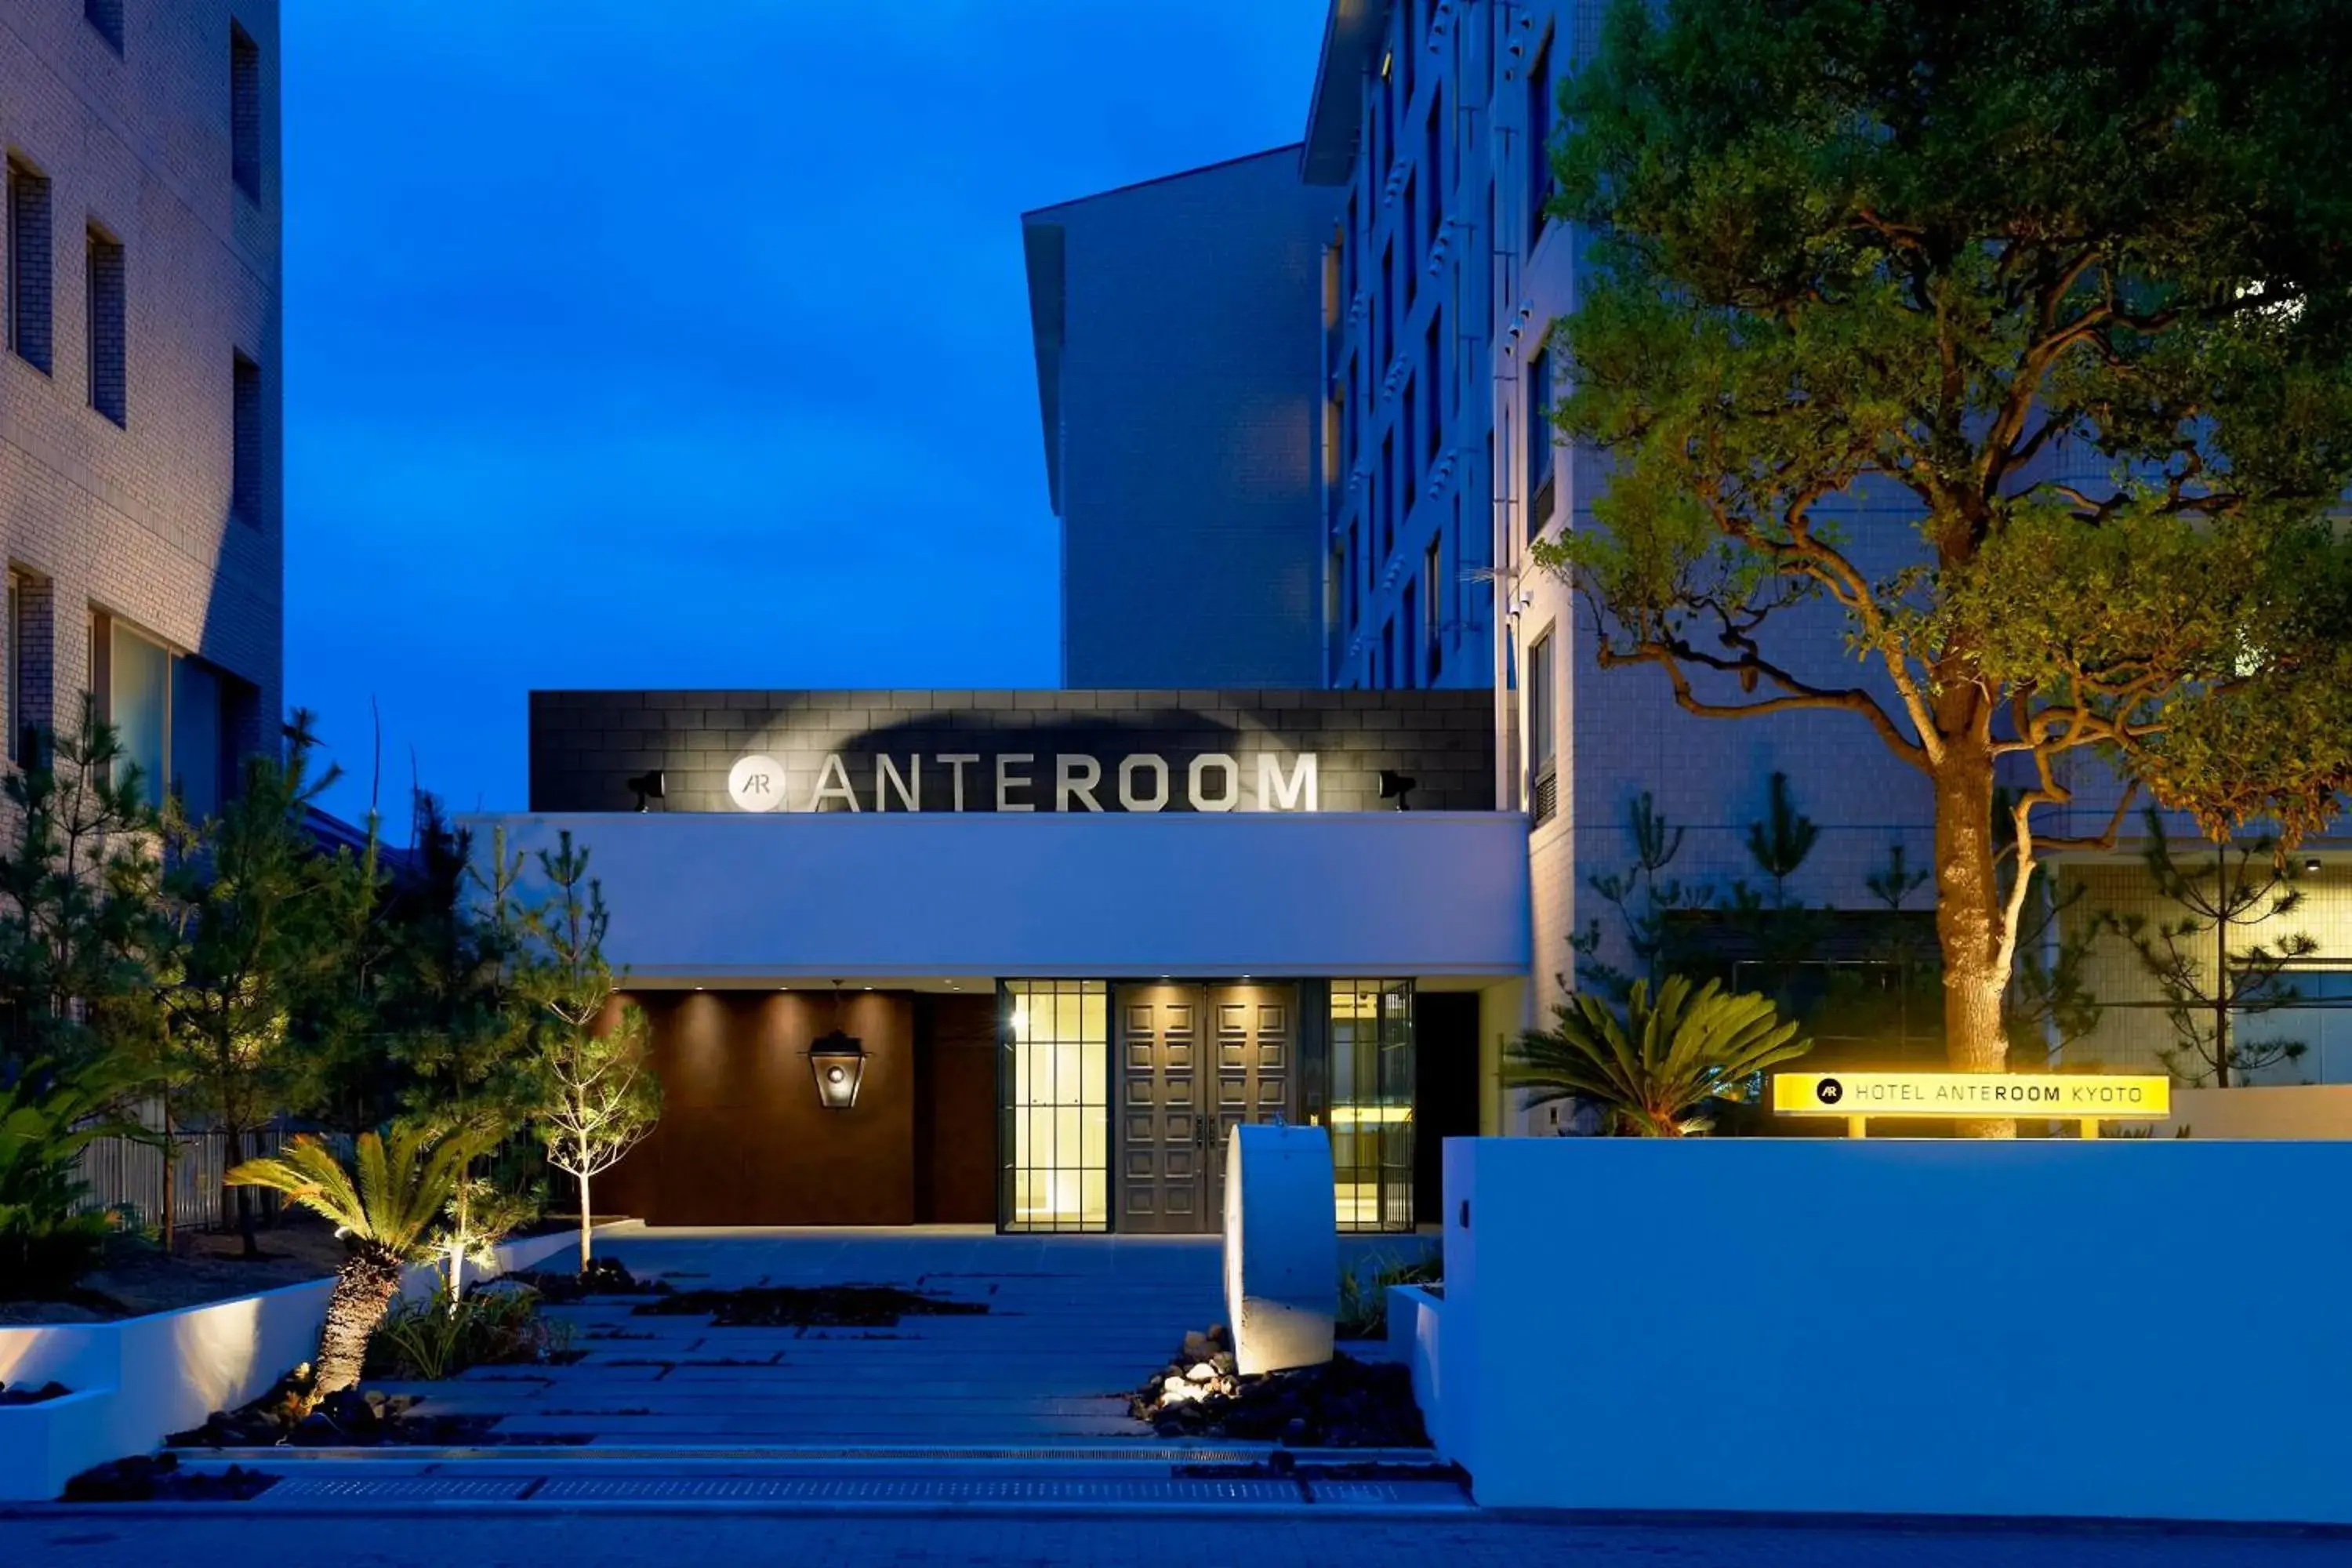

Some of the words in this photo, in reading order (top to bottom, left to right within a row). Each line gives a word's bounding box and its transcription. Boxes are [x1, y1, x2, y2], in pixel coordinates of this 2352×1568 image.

[809, 753, 1319, 812] ANTEROOM
[1857, 1084, 1924, 1100] HOTEL
[1936, 1086, 2060, 1101] ANTEROOM
[2072, 1087, 2142, 1102] KYOTO
